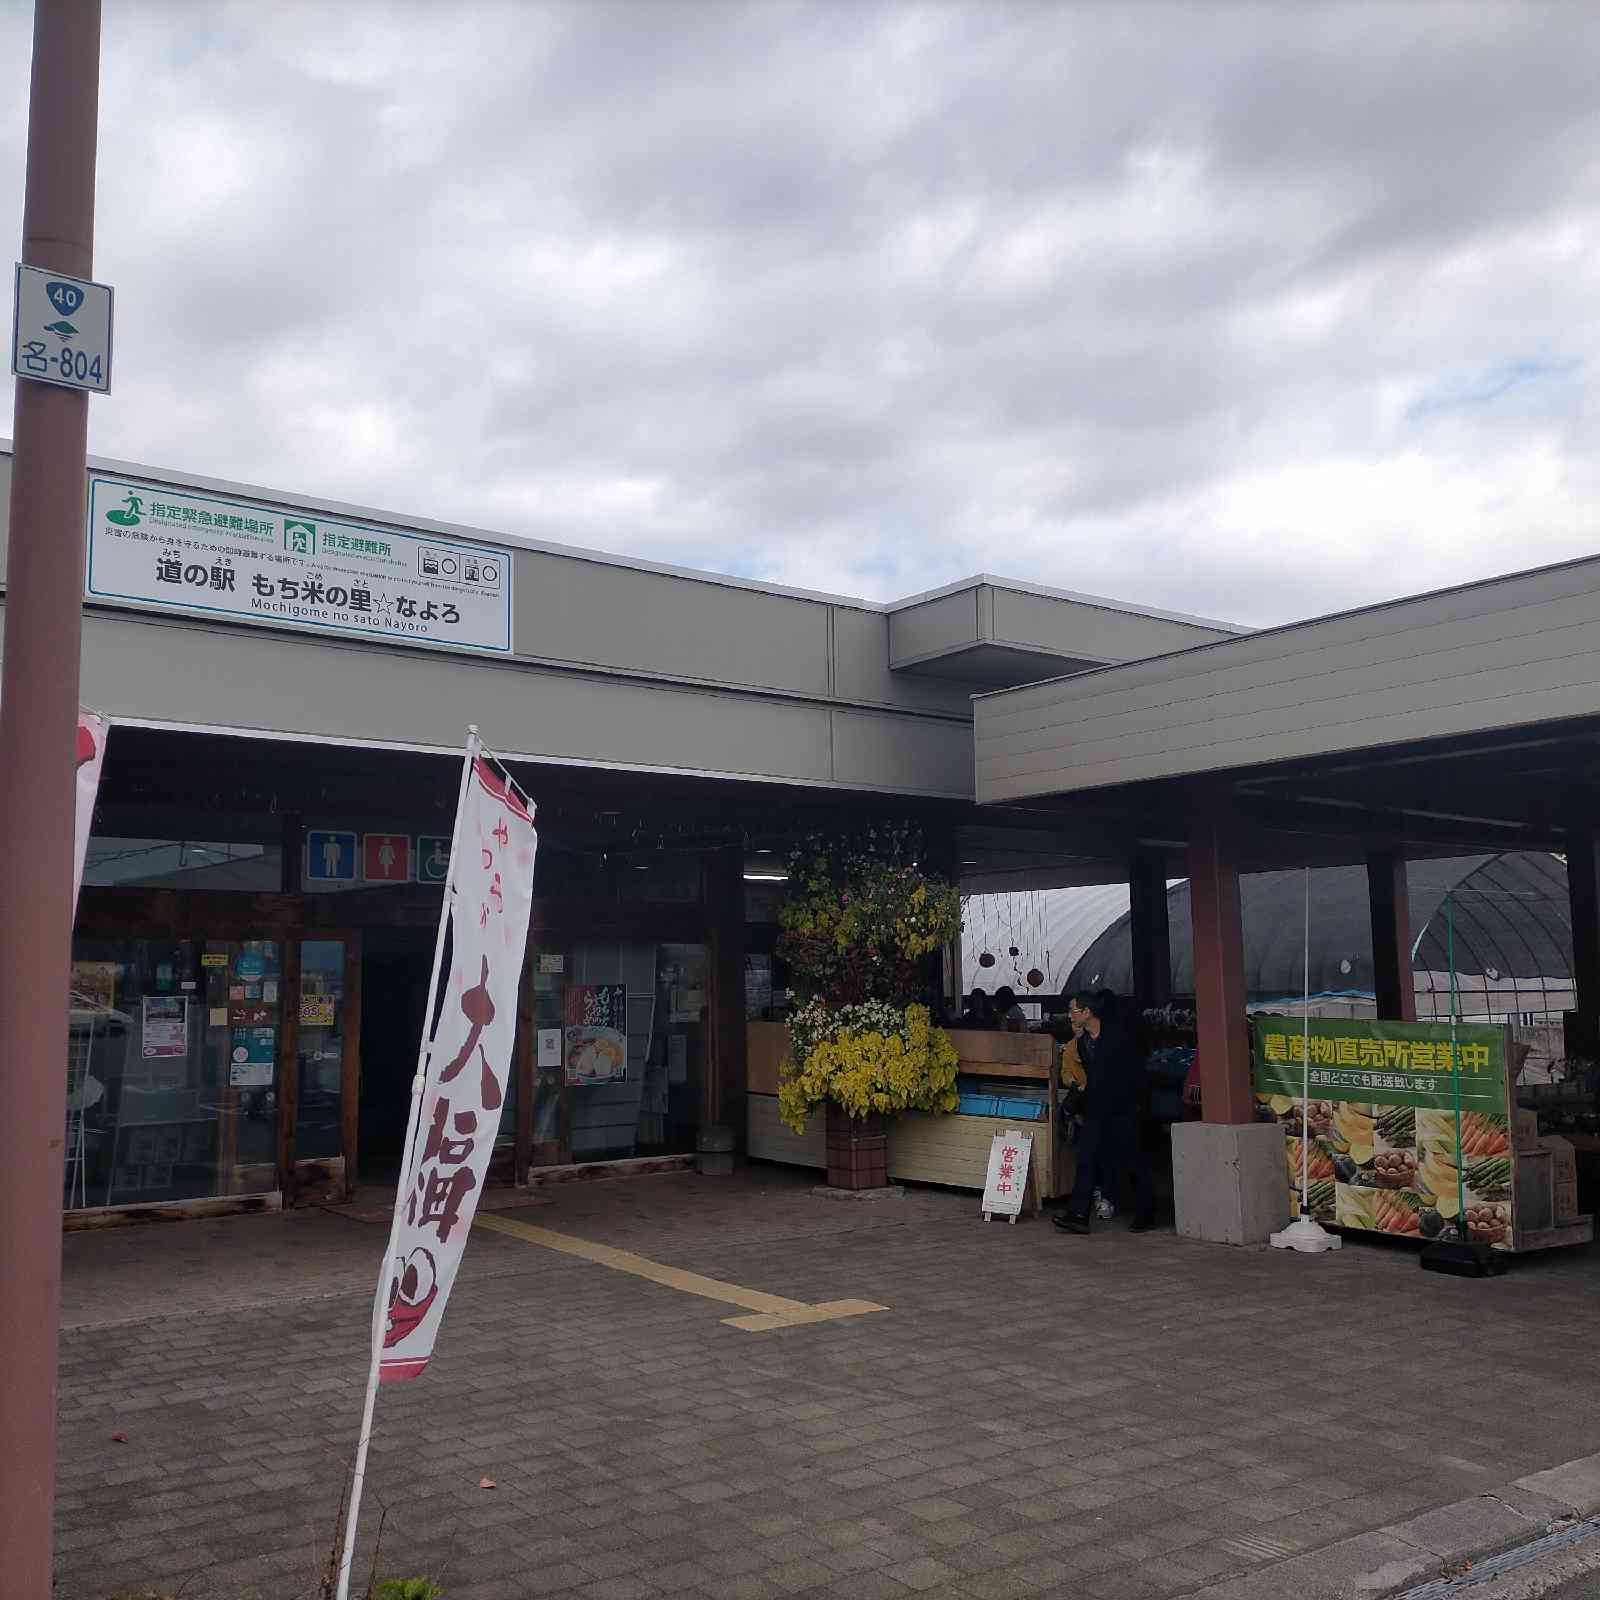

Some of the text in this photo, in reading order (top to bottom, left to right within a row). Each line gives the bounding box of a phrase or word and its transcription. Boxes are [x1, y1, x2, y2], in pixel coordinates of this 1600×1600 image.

[54, 287, 76, 306] 40
[22, 341, 102, 384] 名-804
[150, 502, 274, 536] 指定緊急避難場所
[162, 549, 181, 559] みち
[322, 532, 392, 556] 指定避難所
[156, 557, 236, 593] 道の駅
[215, 557, 233, 567] えき
[307, 571, 324, 581] こめ
[353, 579, 369, 589] さと
[251, 598, 428, 633] Mochigome no sato Nayoro
[1264, 1033, 1490, 1073] 農産物直売所営業中
[997, 1145, 1018, 1197] 営業中
